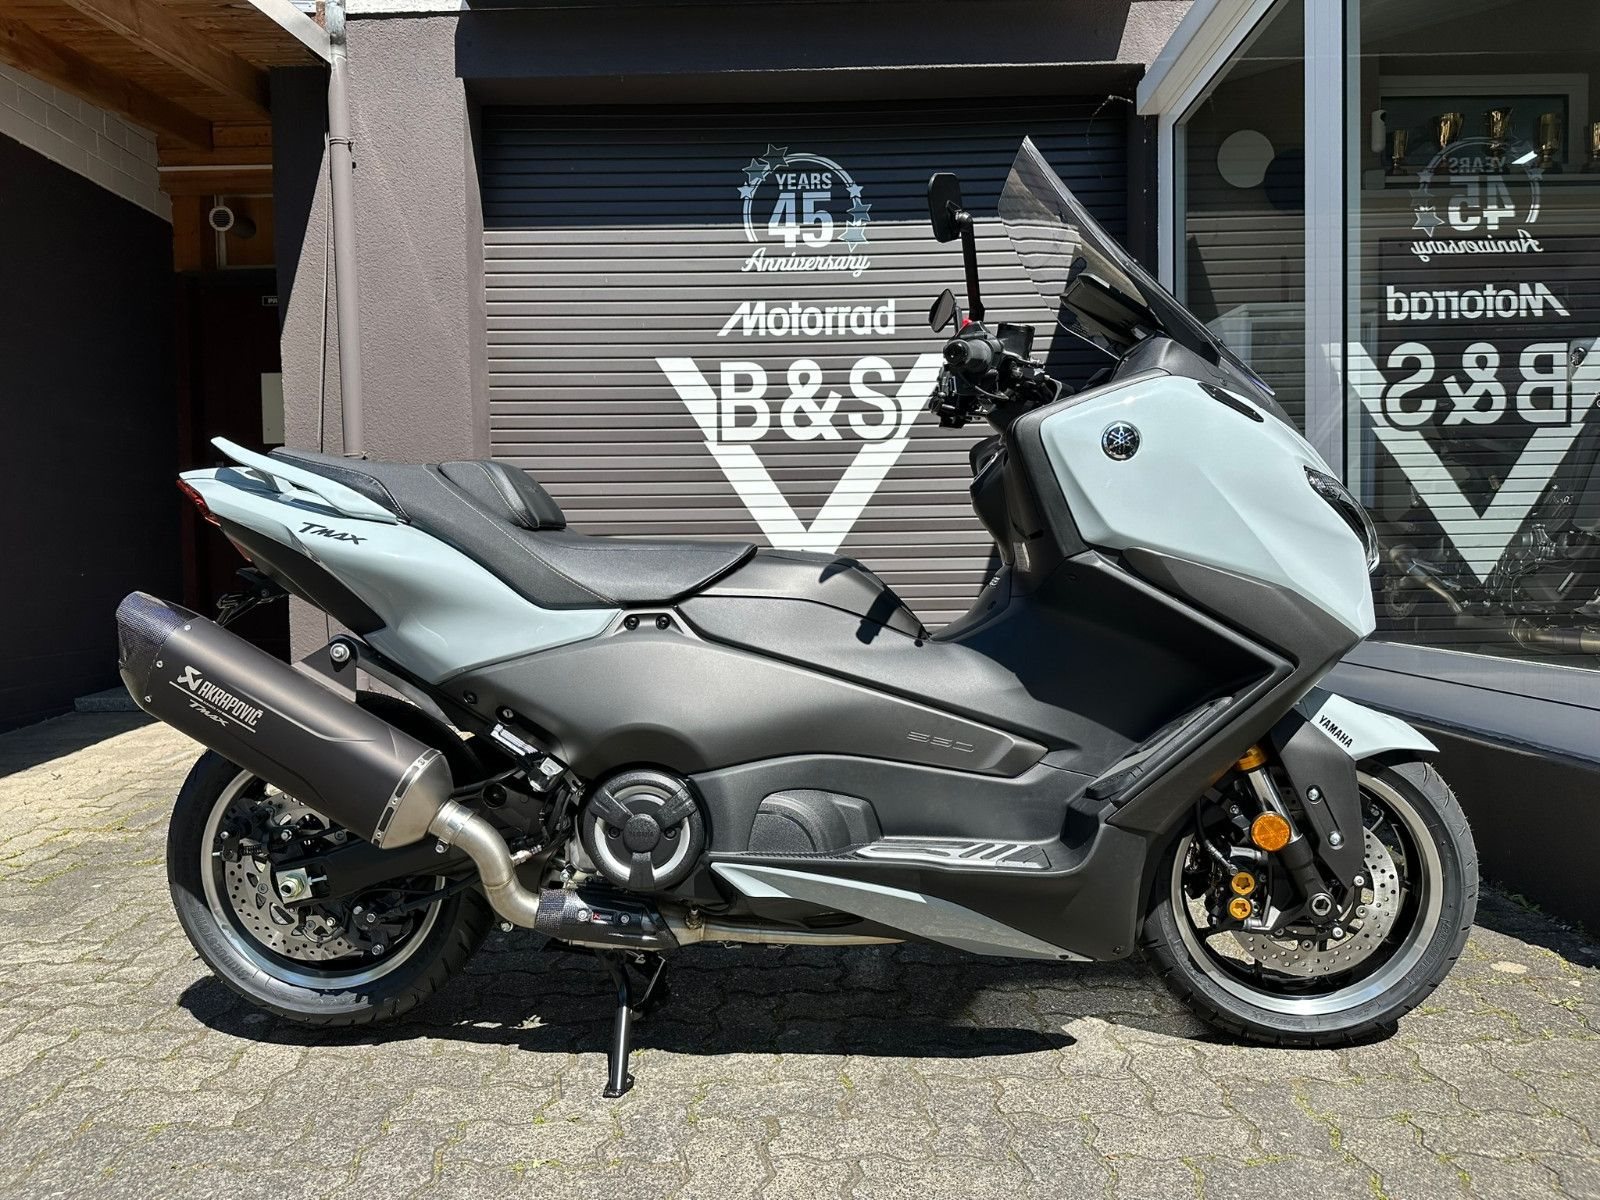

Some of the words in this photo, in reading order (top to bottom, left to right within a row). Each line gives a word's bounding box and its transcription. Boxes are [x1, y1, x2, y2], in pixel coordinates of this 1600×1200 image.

[775, 172, 833, 191] YEARS
[767, 192, 834, 249] 45
[741, 247, 871, 277] Anniversary
[716, 299, 896, 336] Motorrad
[720, 356, 899, 441] B&S
[299, 522, 368, 545] TMAX
[188, 698, 230, 727] TMAX
[1319, 715, 1353, 748] YAMAHA
